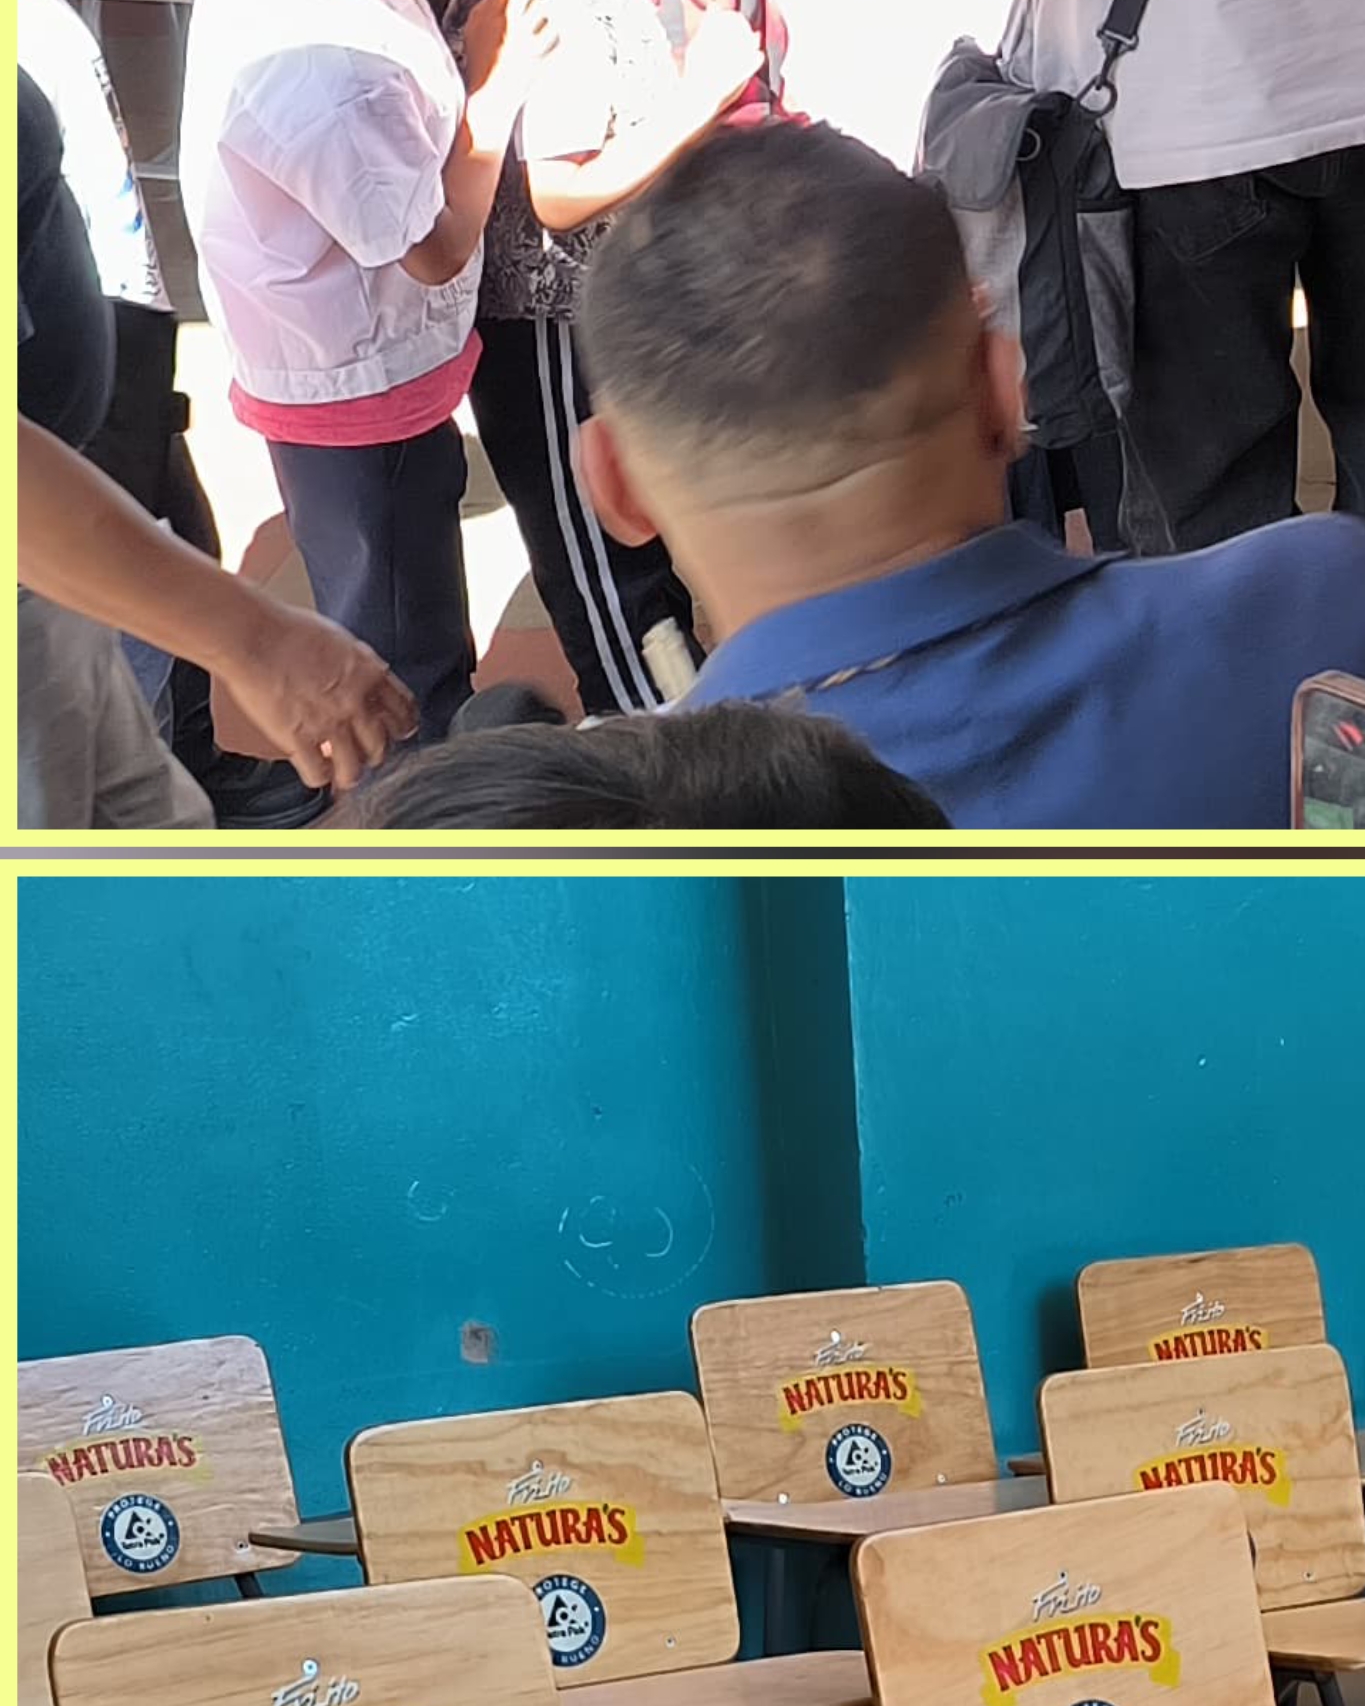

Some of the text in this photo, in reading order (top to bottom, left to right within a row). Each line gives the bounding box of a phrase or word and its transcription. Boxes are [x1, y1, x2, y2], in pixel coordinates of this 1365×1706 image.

[783, 1369, 907, 1416] NATURA'S
[50, 1435, 195, 1483] NATURA'S
[108, 1495, 162, 1520] PROTEGE
[145, 1543, 175, 1571] BUENO
[467, 1505, 628, 1565] NATURA'S
[537, 1574, 588, 1594] ROTEGE
[990, 1621, 1162, 1691] NATURA'S
